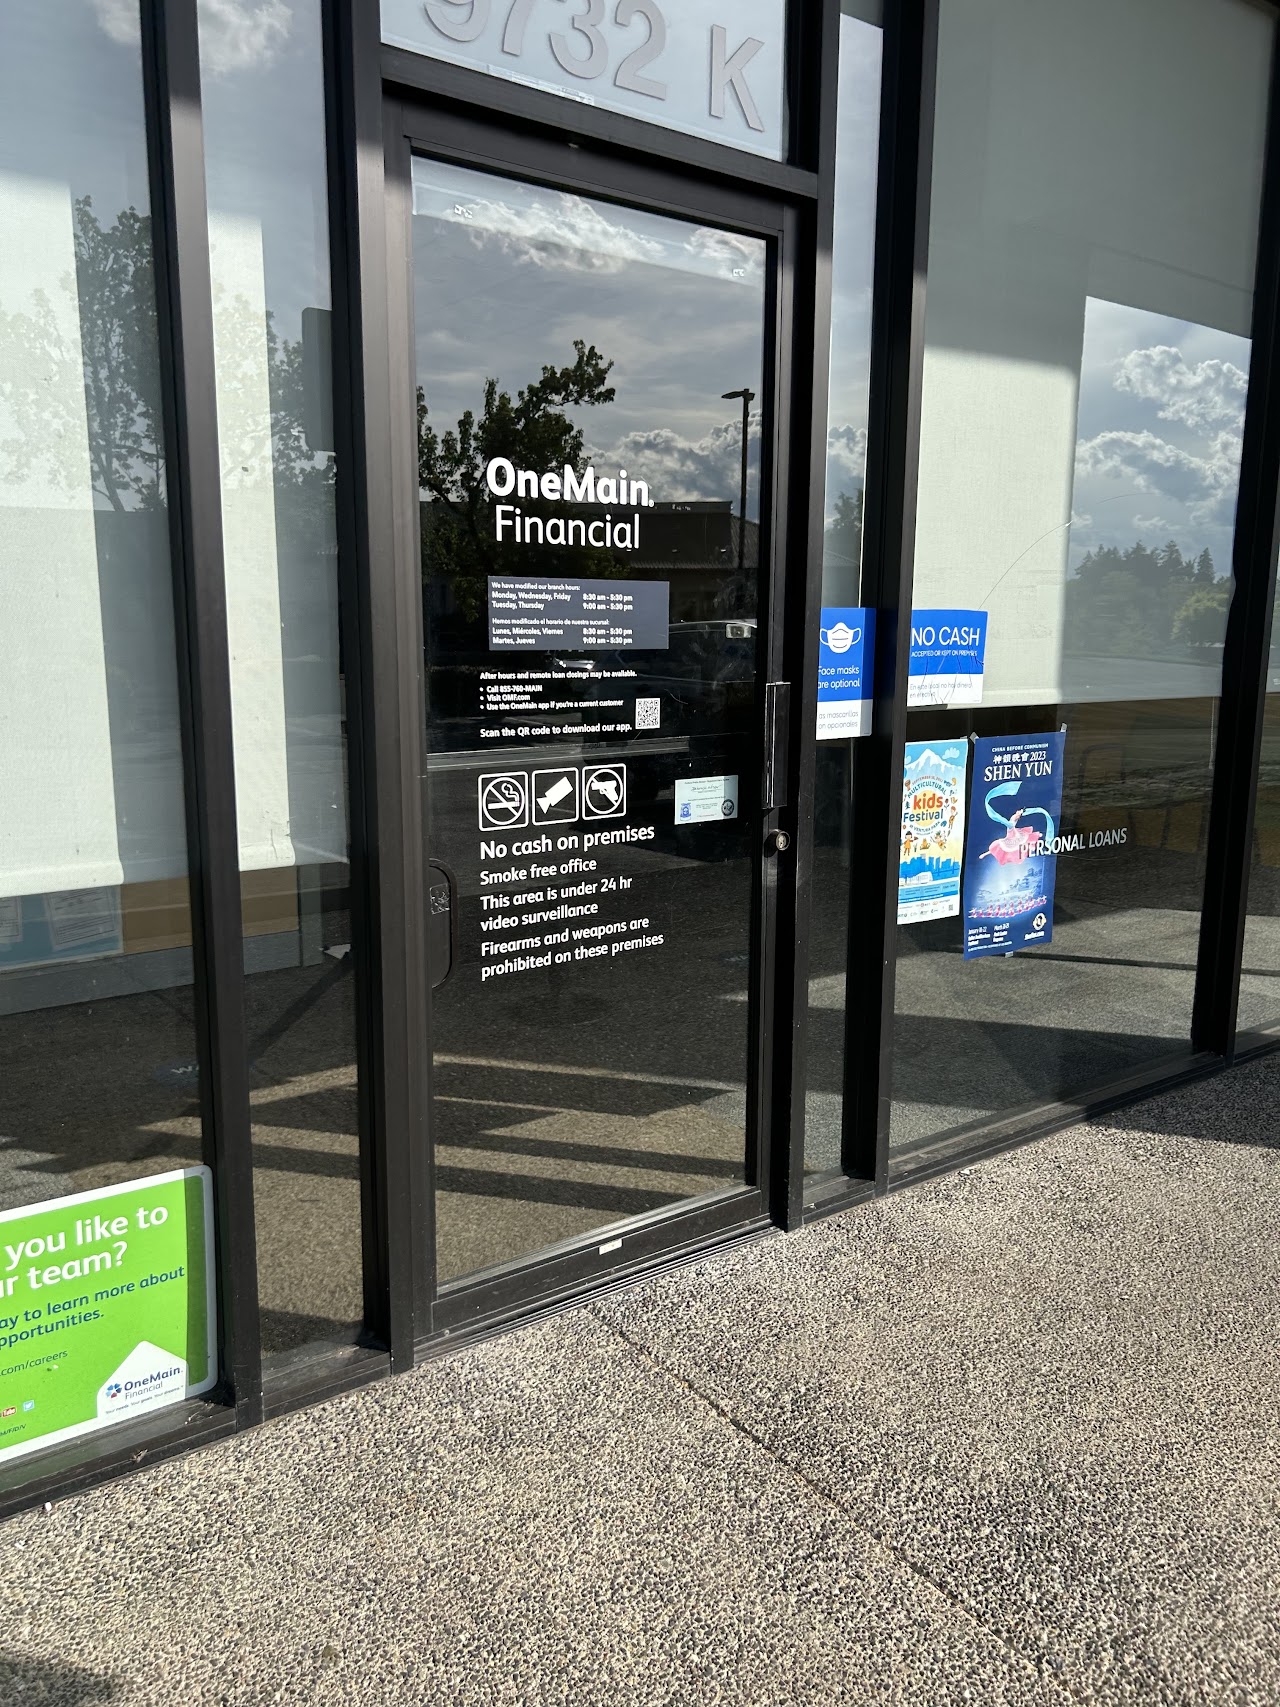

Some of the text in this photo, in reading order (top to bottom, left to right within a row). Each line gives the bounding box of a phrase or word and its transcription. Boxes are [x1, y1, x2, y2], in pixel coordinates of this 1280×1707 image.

[709, 24, 765, 132] K
[495, 504, 640, 549] Financial
[492, 591, 571, 601] Monday, Wednesday, Friday
[492, 601, 544, 610] Tuesday, Thursday
[492, 627, 511, 635] Lunes,
[512, 627, 541, 635] Miércoles,
[911, 626, 980, 646] NO CASH
[911, 650, 934, 658] ACCEPTED
[517, 671, 529, 679] and
[566, 671, 589, 679] closings
[837, 665, 859, 675] masks
[830, 678, 860, 690] optional
[555, 701, 573, 710] you're
[827, 710, 858, 718] mascarillas
[480, 723, 632, 737] Scan the QR code to download our app.
[1030, 751, 1046, 761] 2023
[984, 760, 1053, 782] SHEN YUN
[908, 781, 946, 798] MULTICULTURAL
[913, 793, 943, 810] kids
[903, 808, 943, 822] Festival
[480, 825, 655, 860] No cash on premises
[1019, 828, 1128, 859] PERSONAL LOANS
[480, 858, 597, 885] Smoke free office
[480, 876, 633, 910] This area is under 24 hr
[480, 903, 598, 931] video surveillance
[481, 917, 650, 956] Firearms and weapons are
[481, 933, 664, 981] prohibited on these premises
[4, 1206, 168, 1271] you like to
[27, 1240, 128, 1289] team?
[24, 1309, 42, 1322] to
[47, 1295, 89, 1316] learn
[95, 1282, 135, 1302] more
[140, 1266, 185, 1289] about
[125, 1381, 163, 1400] Financial
